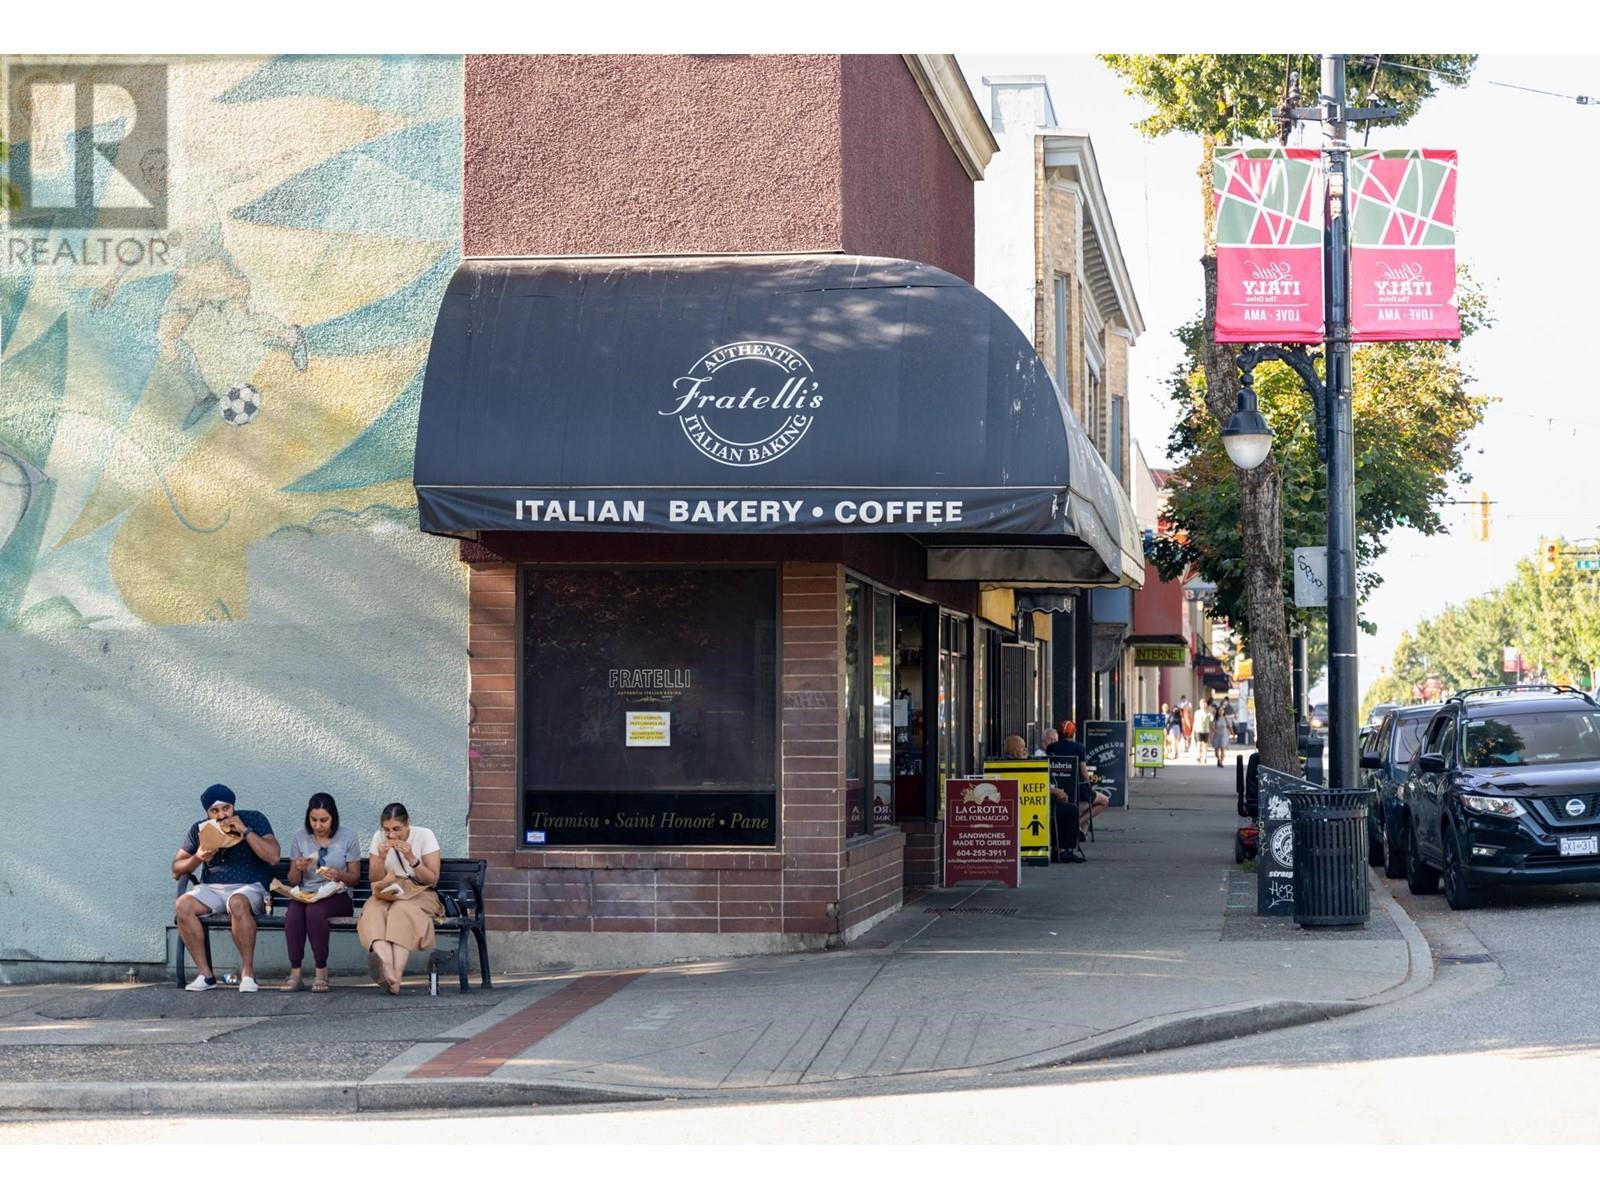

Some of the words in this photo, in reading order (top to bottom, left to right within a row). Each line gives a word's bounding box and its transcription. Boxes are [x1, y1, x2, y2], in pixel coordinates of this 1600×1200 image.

[704, 344, 803, 371] AUTHENTIC
[658, 376, 824, 415] Fratelli's
[685, 414, 744, 462] ITALIAN
[748, 414, 807, 462] BAKING
[515, 499, 645, 522] ITALIAN
[668, 499, 803, 523] BAKERY
[834, 500, 963, 524] COFFEE
[608, 668, 691, 688] FRATELLI
[1022, 783, 1046, 793] KEEP
[532, 812, 599, 828] Tiramisu
[615, 812, 656, 828] Saint
[660, 811, 716, 829] Honoré
[729, 813, 769, 829] Pane
[955, 806, 968, 814] LA
[968, 805, 1009, 814] GROTTA
